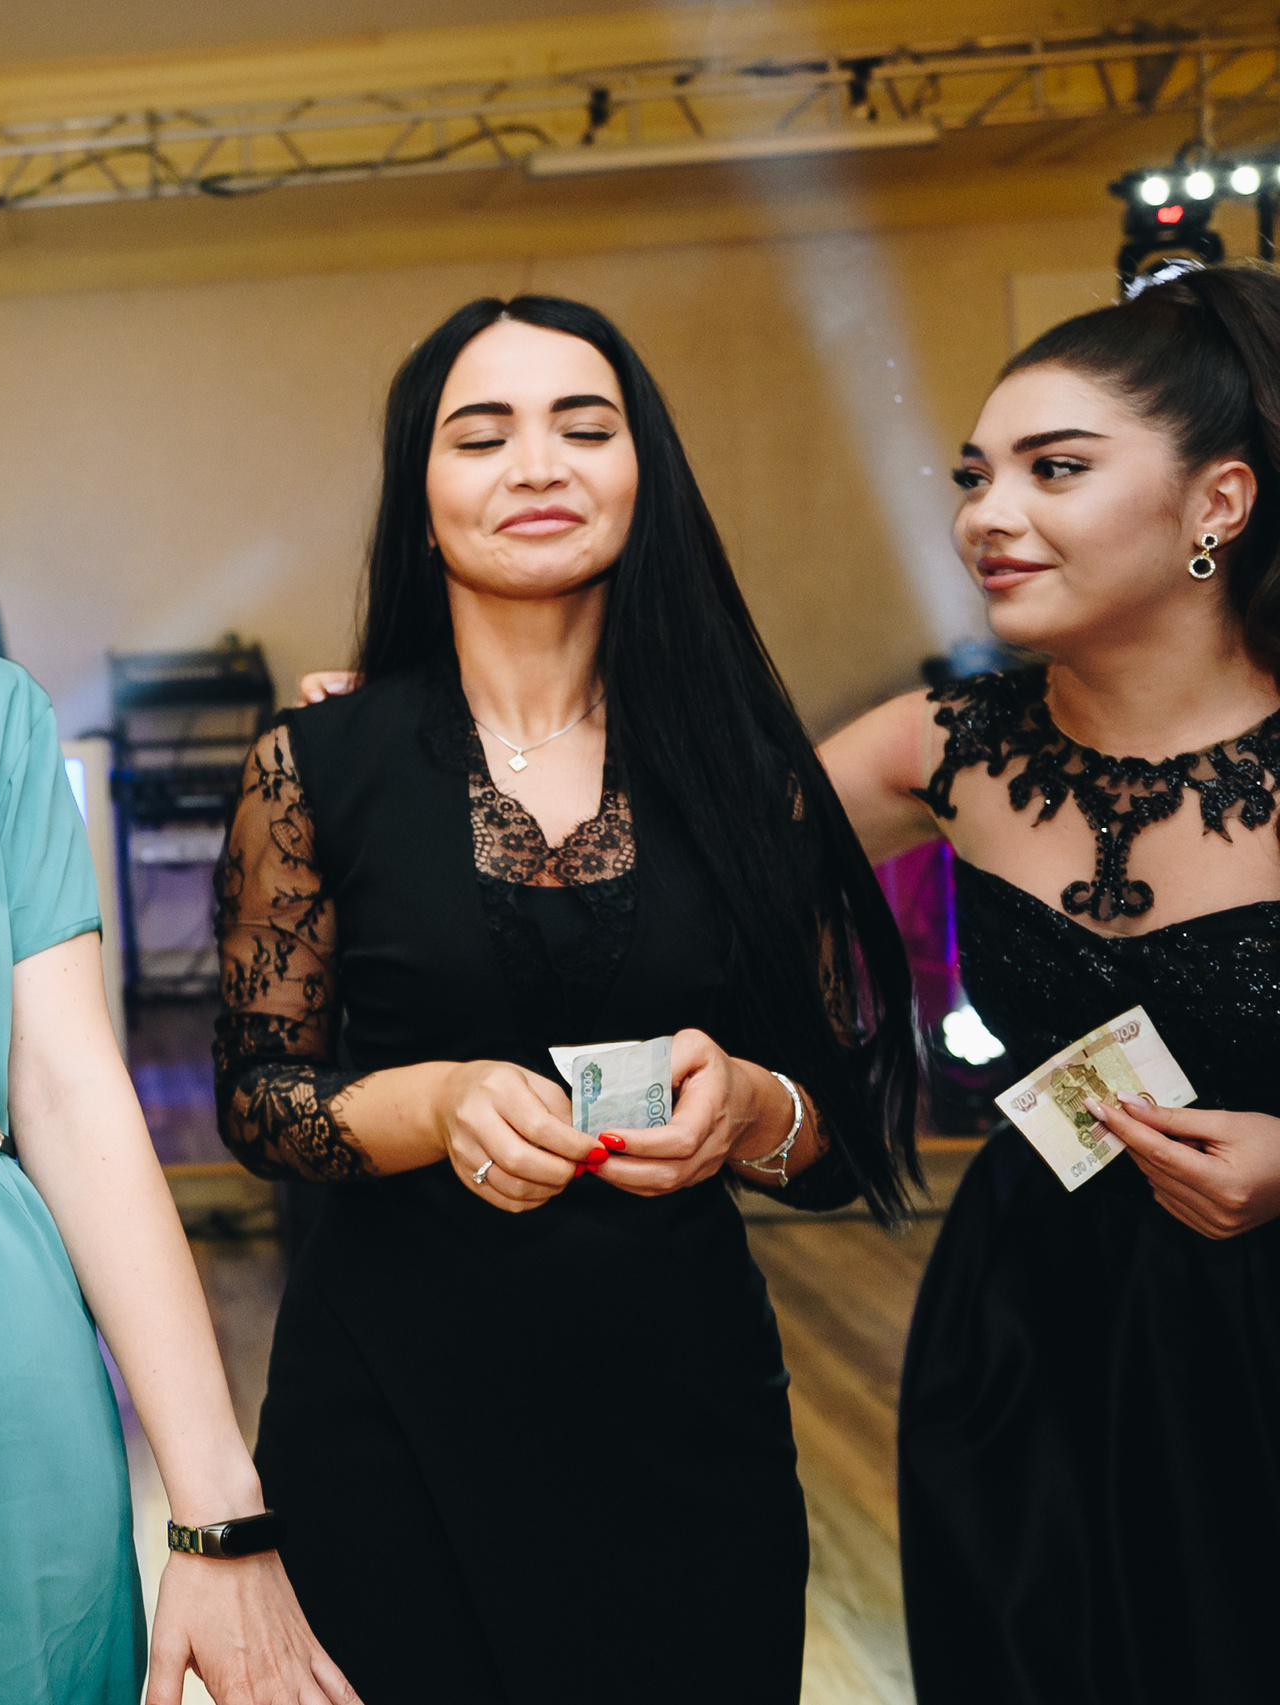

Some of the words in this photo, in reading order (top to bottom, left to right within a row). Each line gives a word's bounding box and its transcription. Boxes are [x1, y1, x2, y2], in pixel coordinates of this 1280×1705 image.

[1113, 1021, 1140, 1043] 100
[583, 1070, 593, 1098] 1000
[646, 1083, 667, 1128] 000
[1013, 1091, 1037, 1111] 100
